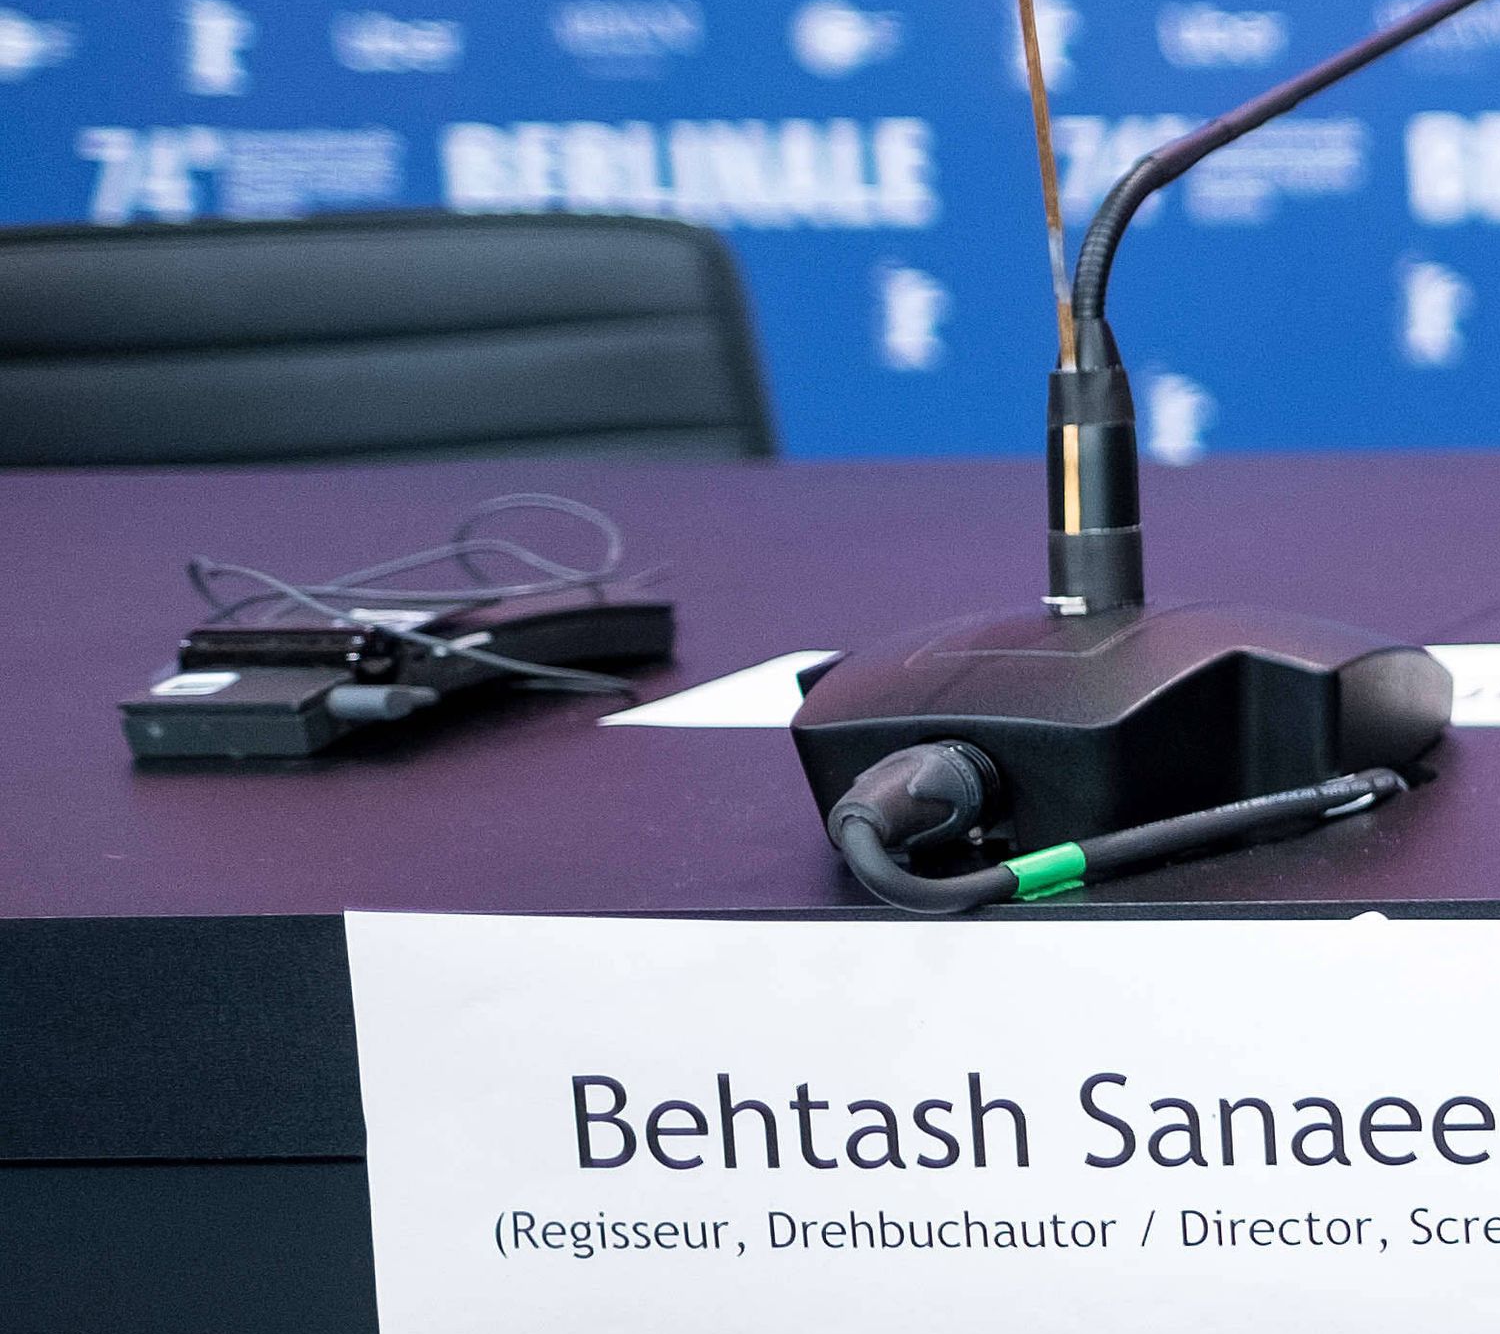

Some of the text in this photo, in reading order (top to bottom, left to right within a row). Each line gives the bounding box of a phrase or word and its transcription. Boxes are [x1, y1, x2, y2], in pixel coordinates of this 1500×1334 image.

[440, 117, 937, 227] BERLINALE
[570, 1072, 1031, 1171] Behtash
[493, 1208, 746, 1259] (Regisseur,
[767, 1209, 1118, 1250] Drehbuchautor
[1140, 1209, 1157, 1248] /
[1180, 1208, 1389, 1253] Director,
